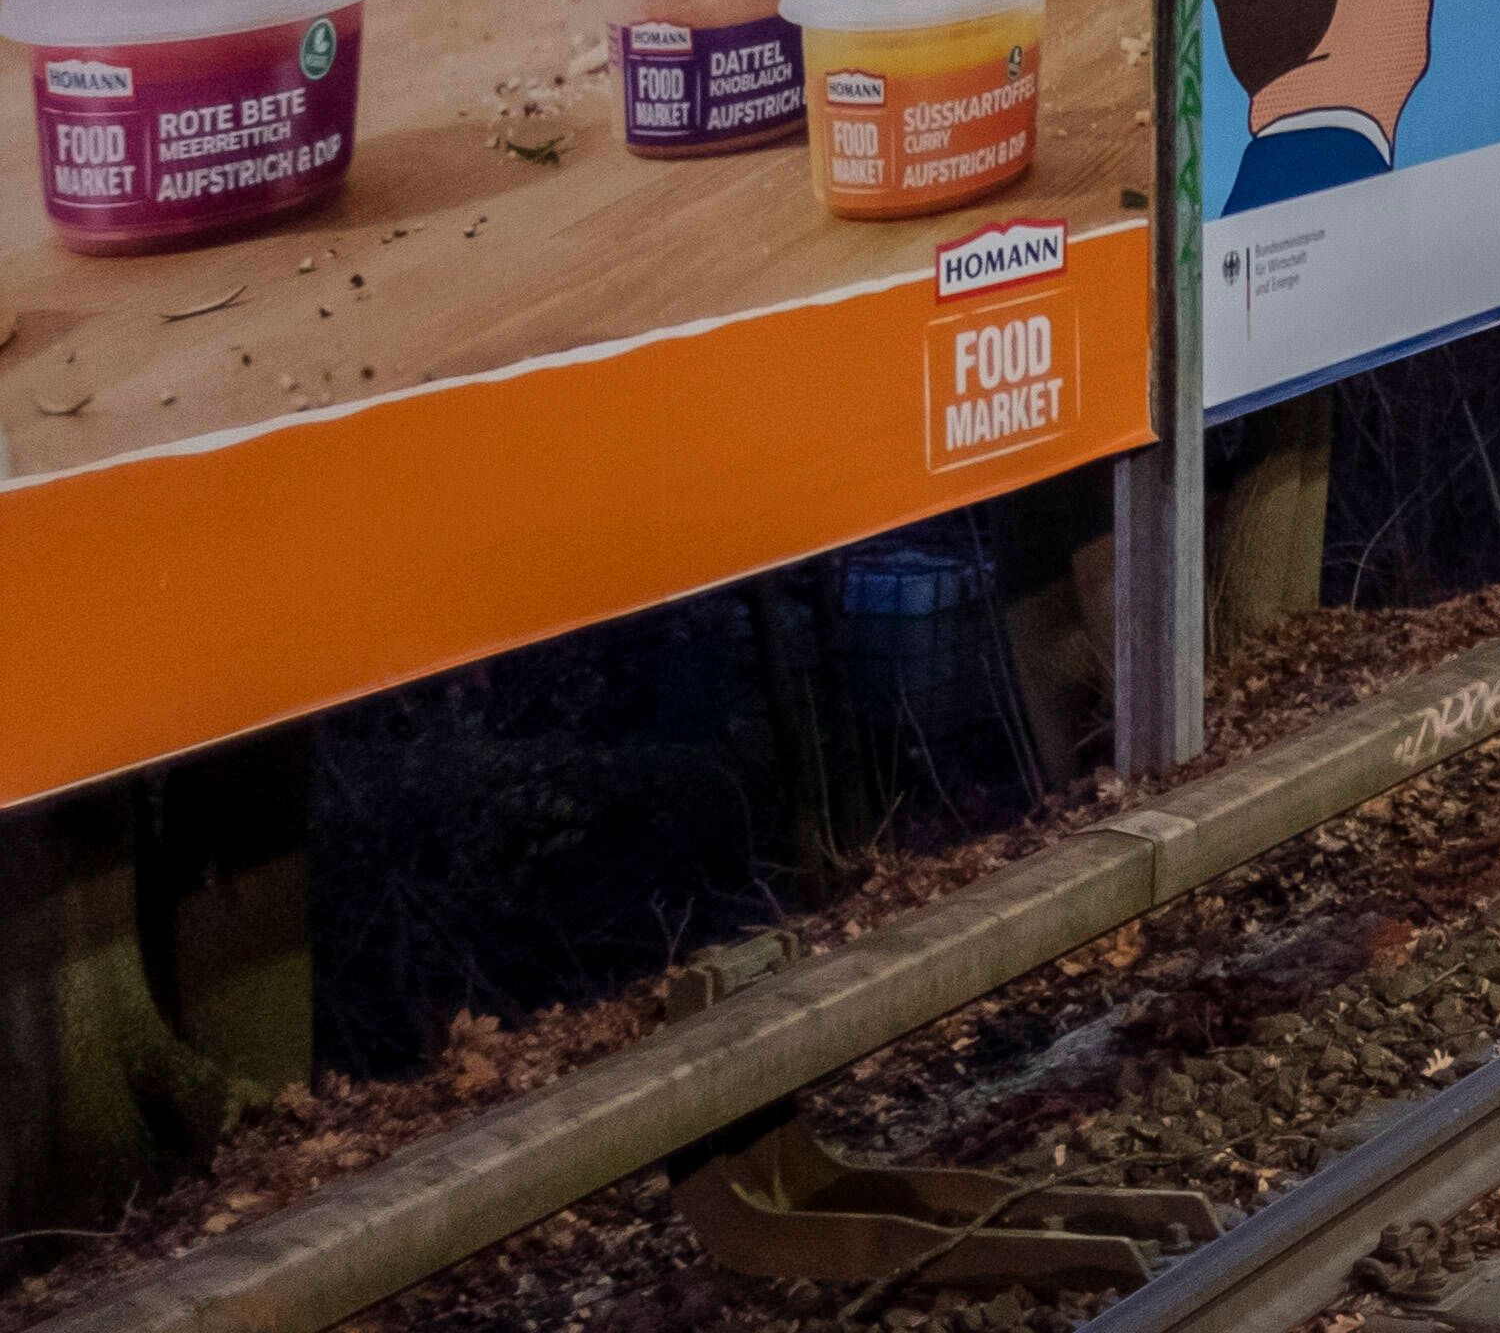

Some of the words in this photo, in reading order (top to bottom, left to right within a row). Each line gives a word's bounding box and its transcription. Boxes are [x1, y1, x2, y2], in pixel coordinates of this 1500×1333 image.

[711, 39, 785, 77] DATTEL
[637, 66, 684, 100] FOOD
[709, 62, 793, 98] KNOBLAUCH
[159, 103, 235, 139] ROTE
[241, 87, 307, 127] BETE
[707, 86, 800, 131] AUFSTRICH
[57, 124, 127, 165] FOOD
[159, 120, 291, 162] MEERRETTICH
[833, 121, 880, 156] FOOD
[55, 165, 136, 196] MARKET
[156, 152, 294, 202] AUFSTRICH
[902, 150, 996, 189] AUFSTRICH
[944, 235, 1059, 285] HOMANN
[955, 315, 1052, 395] FOOD
[945, 378, 1064, 452] MARKET
